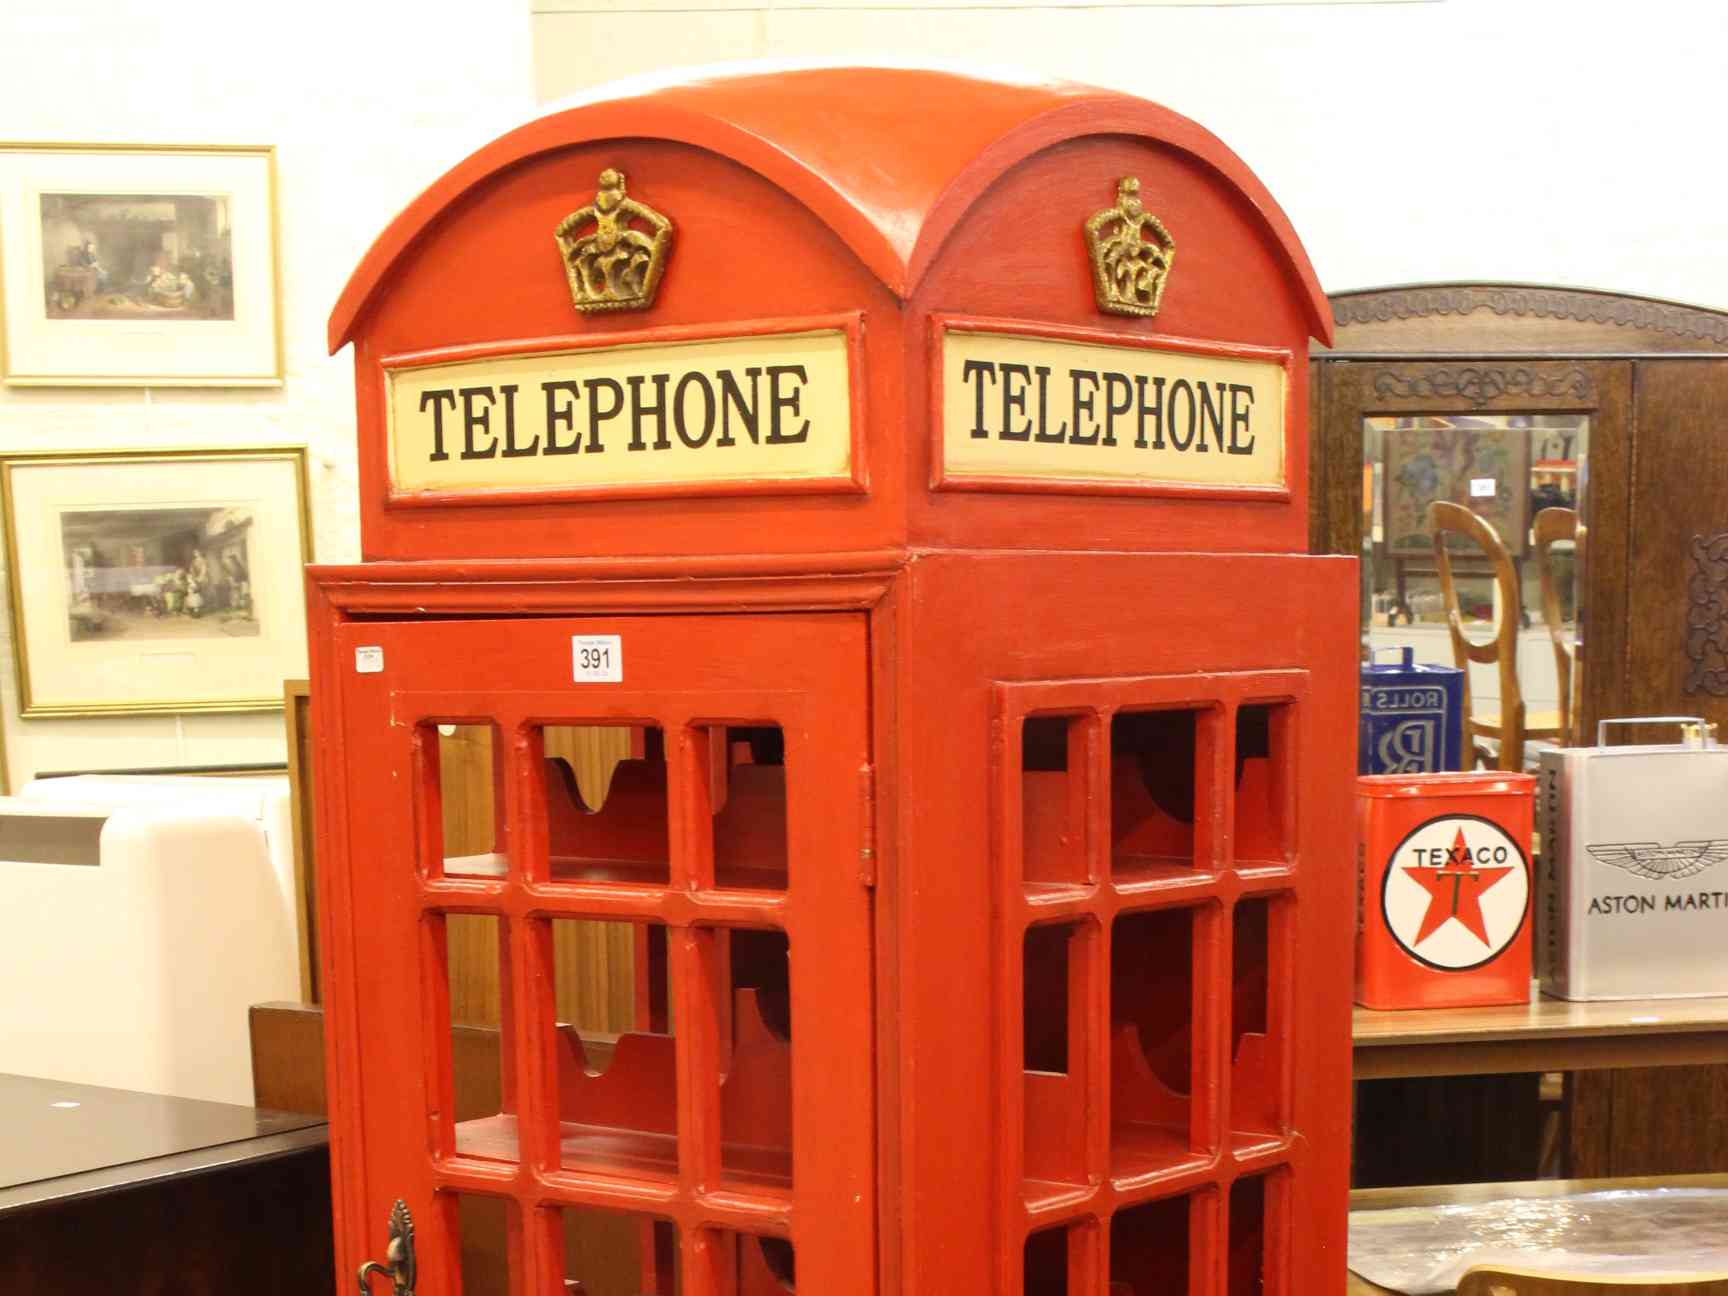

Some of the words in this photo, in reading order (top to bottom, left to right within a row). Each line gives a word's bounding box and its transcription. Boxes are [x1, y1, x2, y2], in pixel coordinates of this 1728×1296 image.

[419, 365, 810, 462] TELEPHONE
[963, 359, 1255, 456] TELEPHONE
[580, 648, 609, 669] 391
[1413, 846, 1508, 867] TEXACO
[1588, 895, 1655, 915] ASTON
